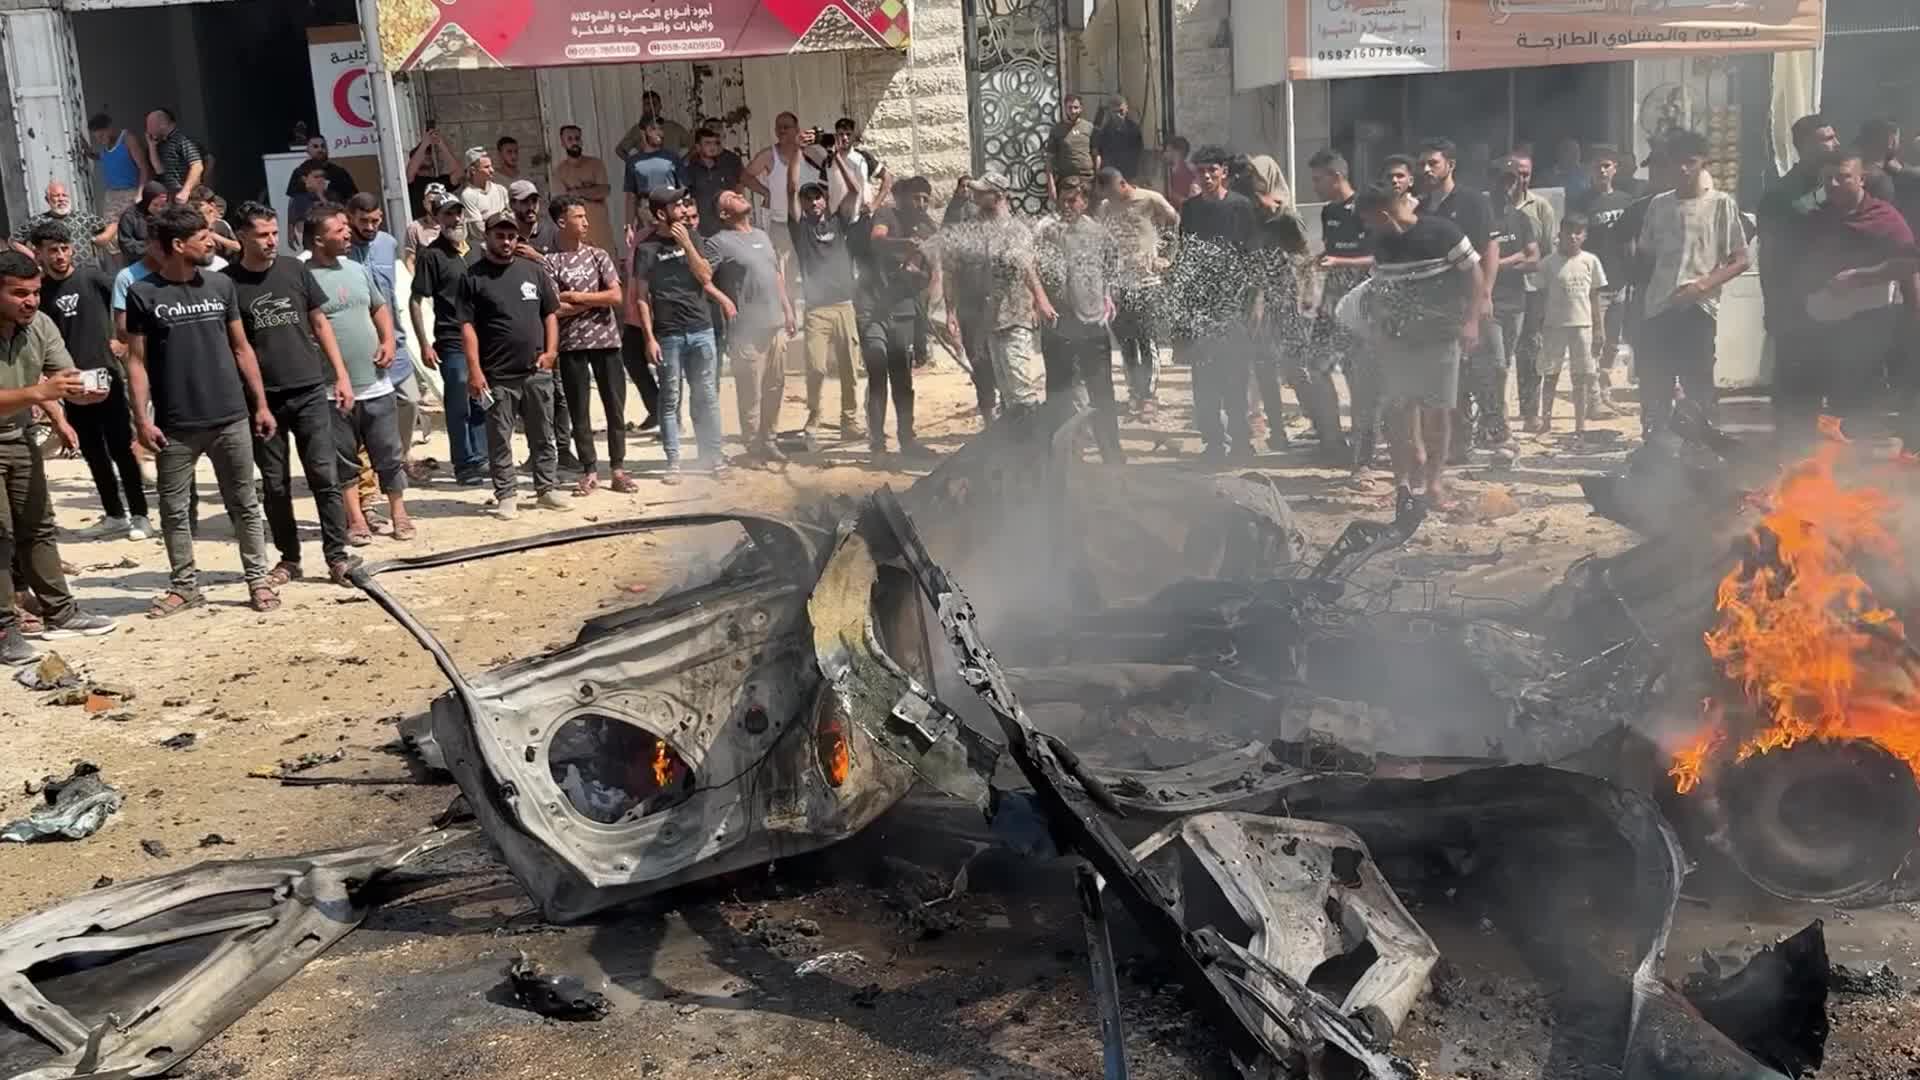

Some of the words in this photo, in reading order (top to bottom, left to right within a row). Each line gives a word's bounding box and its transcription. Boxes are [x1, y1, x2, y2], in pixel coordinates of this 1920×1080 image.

[618, 7, 662, 22] المكسرات
[1516, 31, 1599, 50] الطازجة
[154, 298, 225, 320] Columbia
[254, 311, 300, 329] ACOSTE
